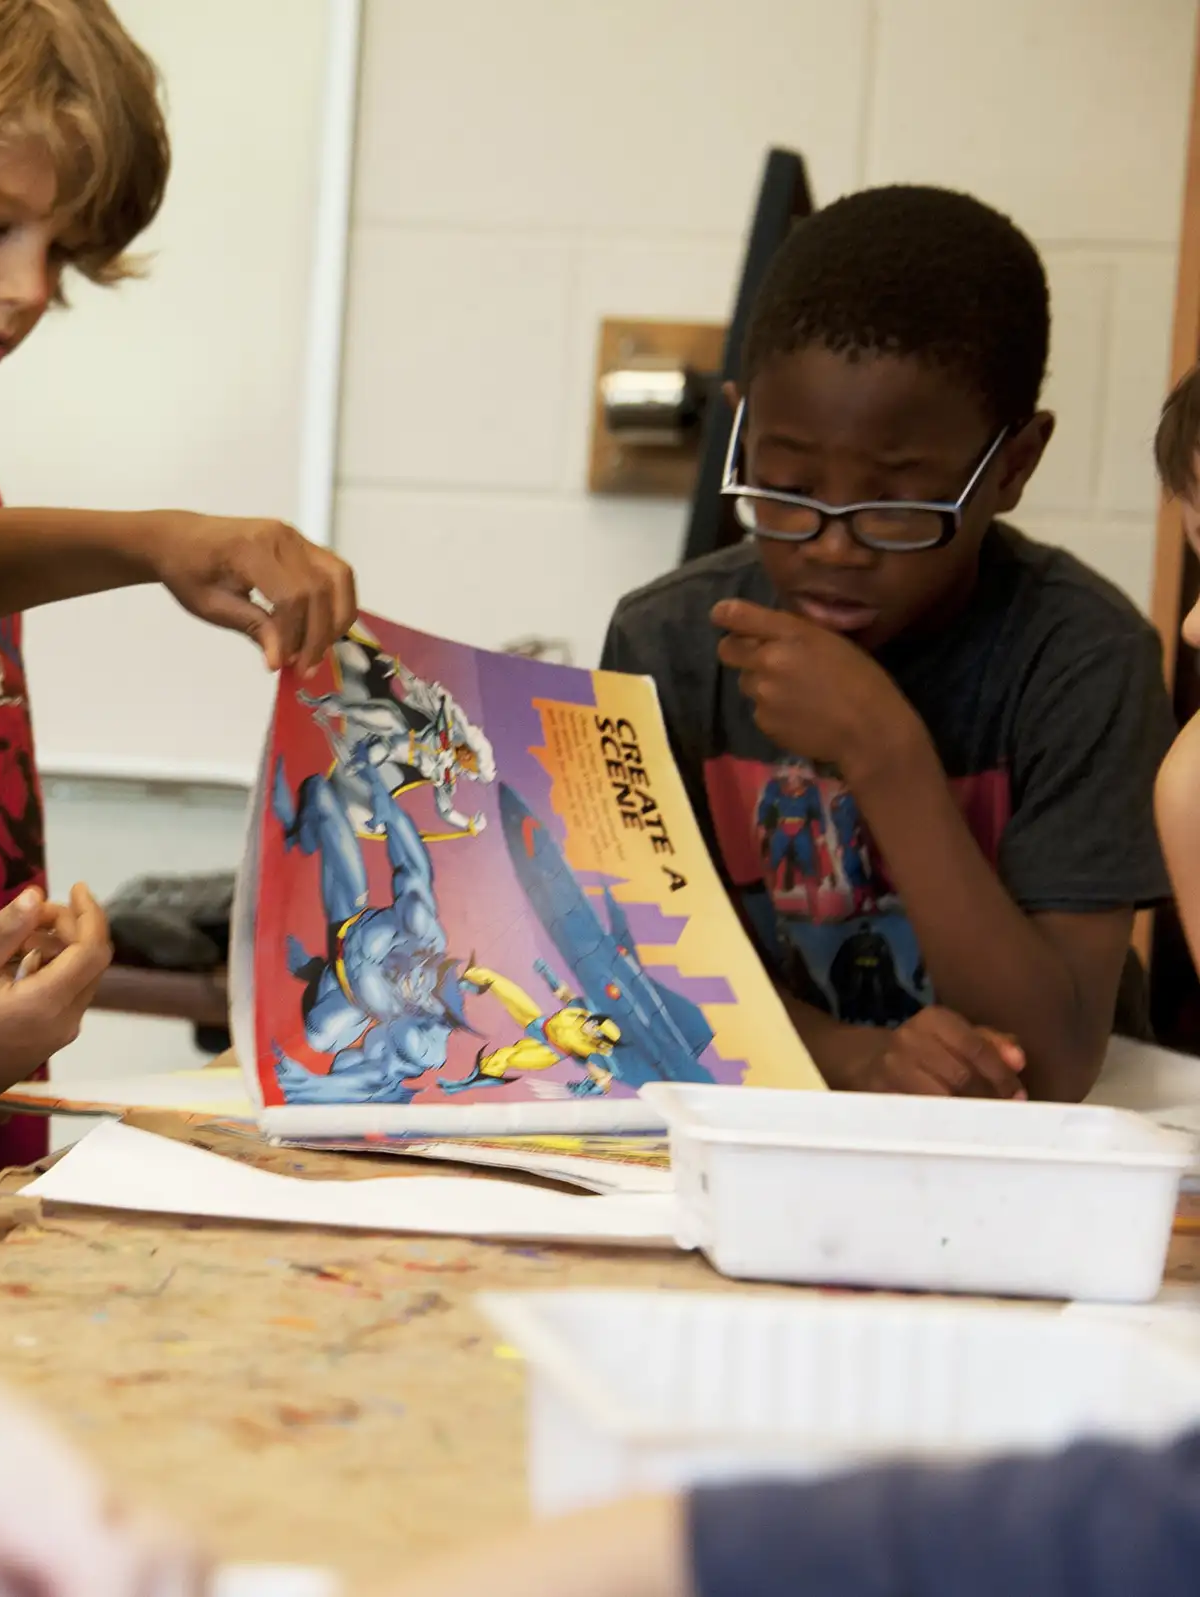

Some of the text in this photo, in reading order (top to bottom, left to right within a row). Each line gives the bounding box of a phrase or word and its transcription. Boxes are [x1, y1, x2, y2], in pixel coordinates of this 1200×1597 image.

[594, 714, 644, 832] SCENE
[616, 718, 688, 892] CREATE A
